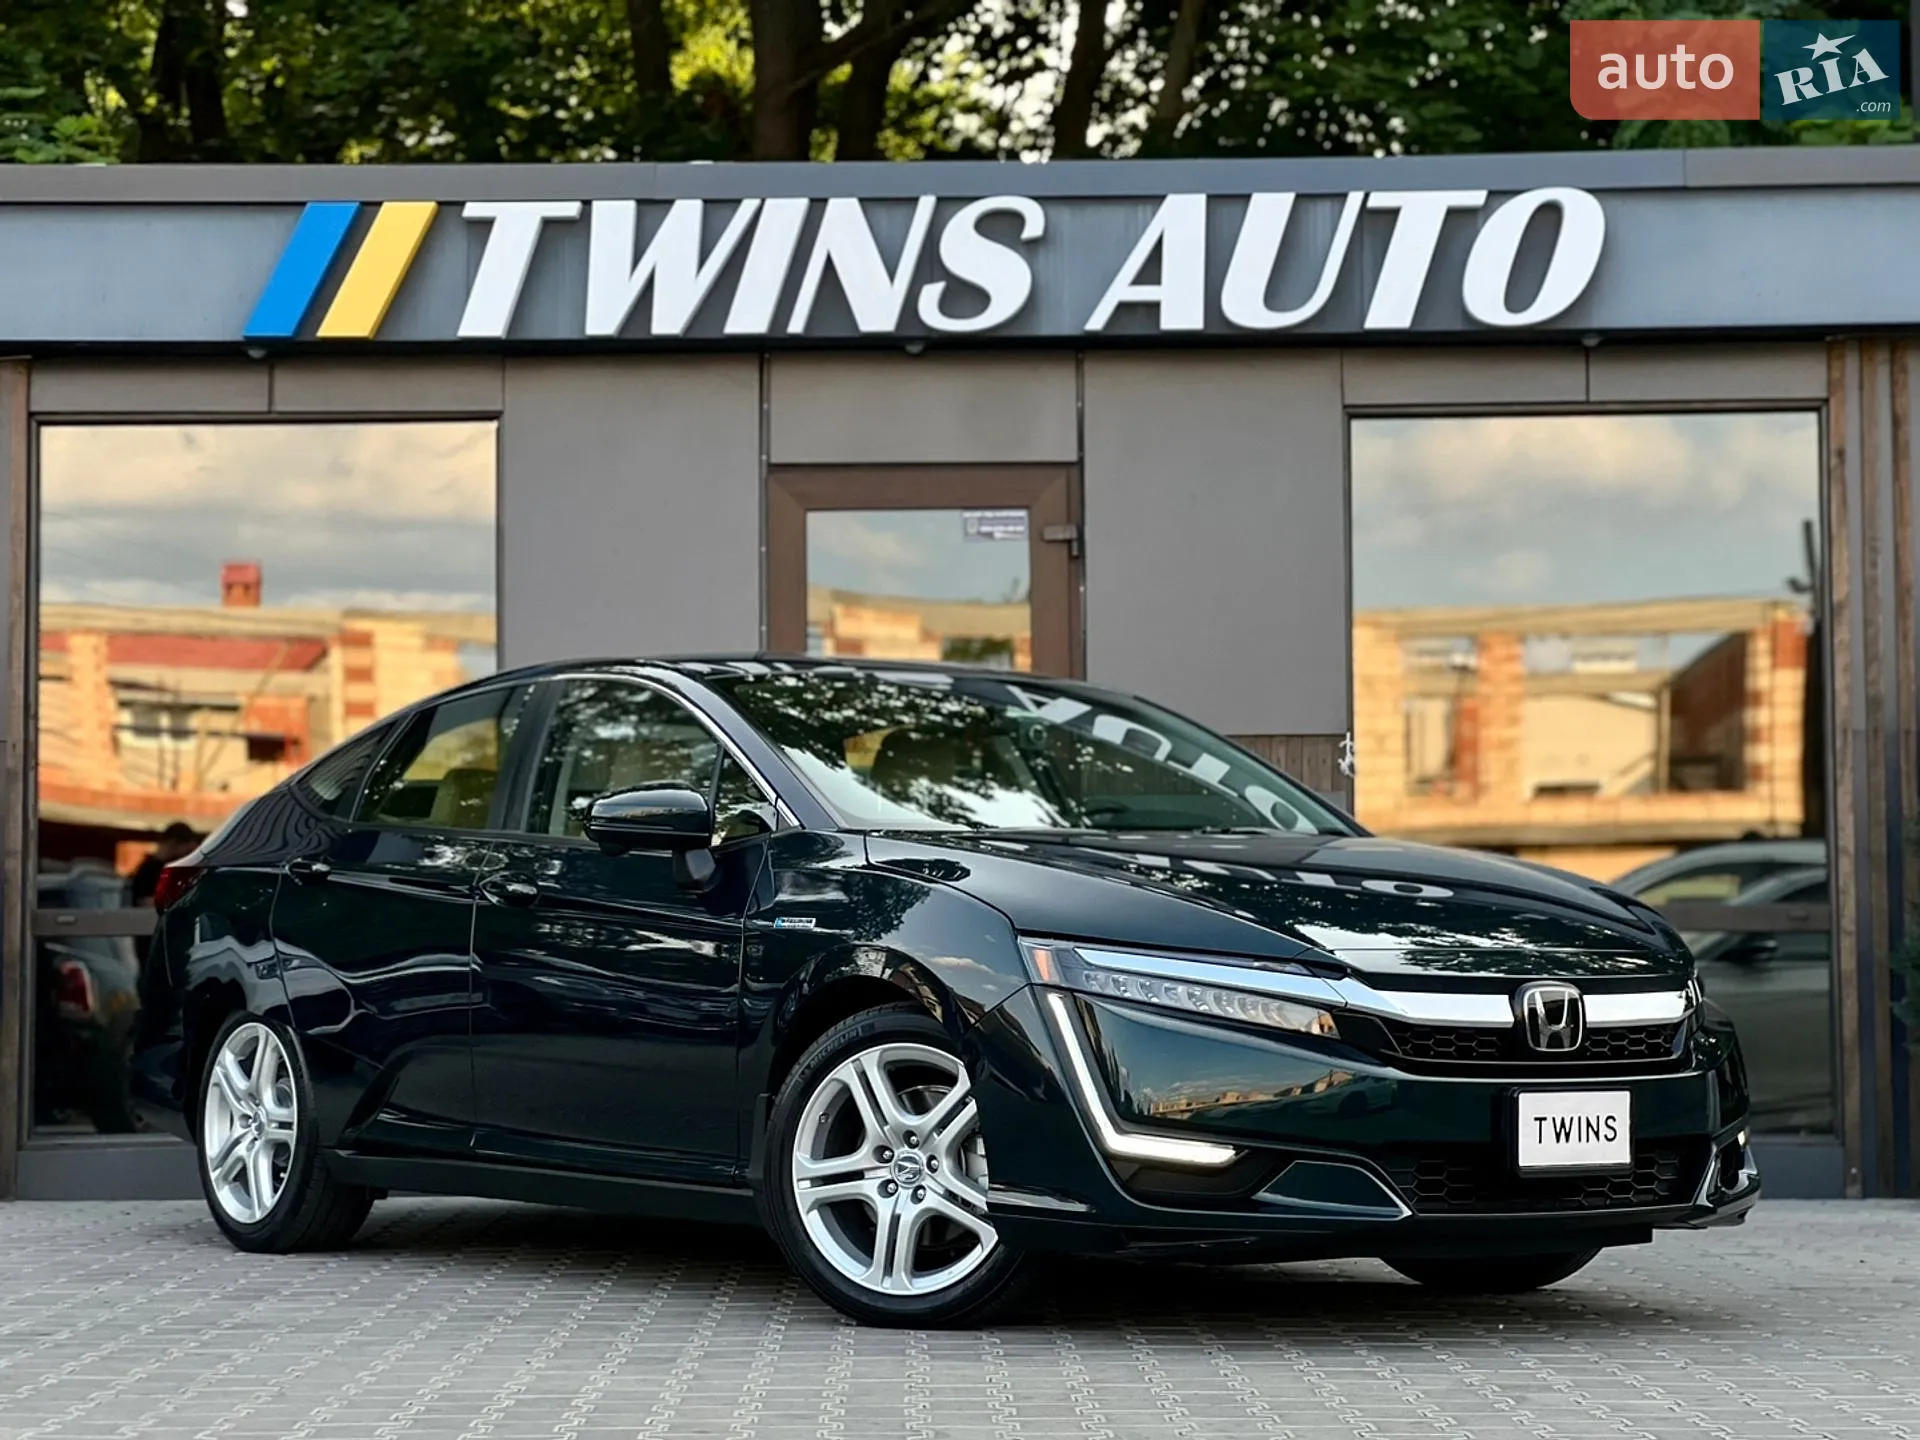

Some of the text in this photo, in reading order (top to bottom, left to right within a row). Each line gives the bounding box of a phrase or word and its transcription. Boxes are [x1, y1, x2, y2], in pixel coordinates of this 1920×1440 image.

[457, 187, 1606, 339] TWINS AUTO
[1534, 1115, 1617, 1144] TWINS
